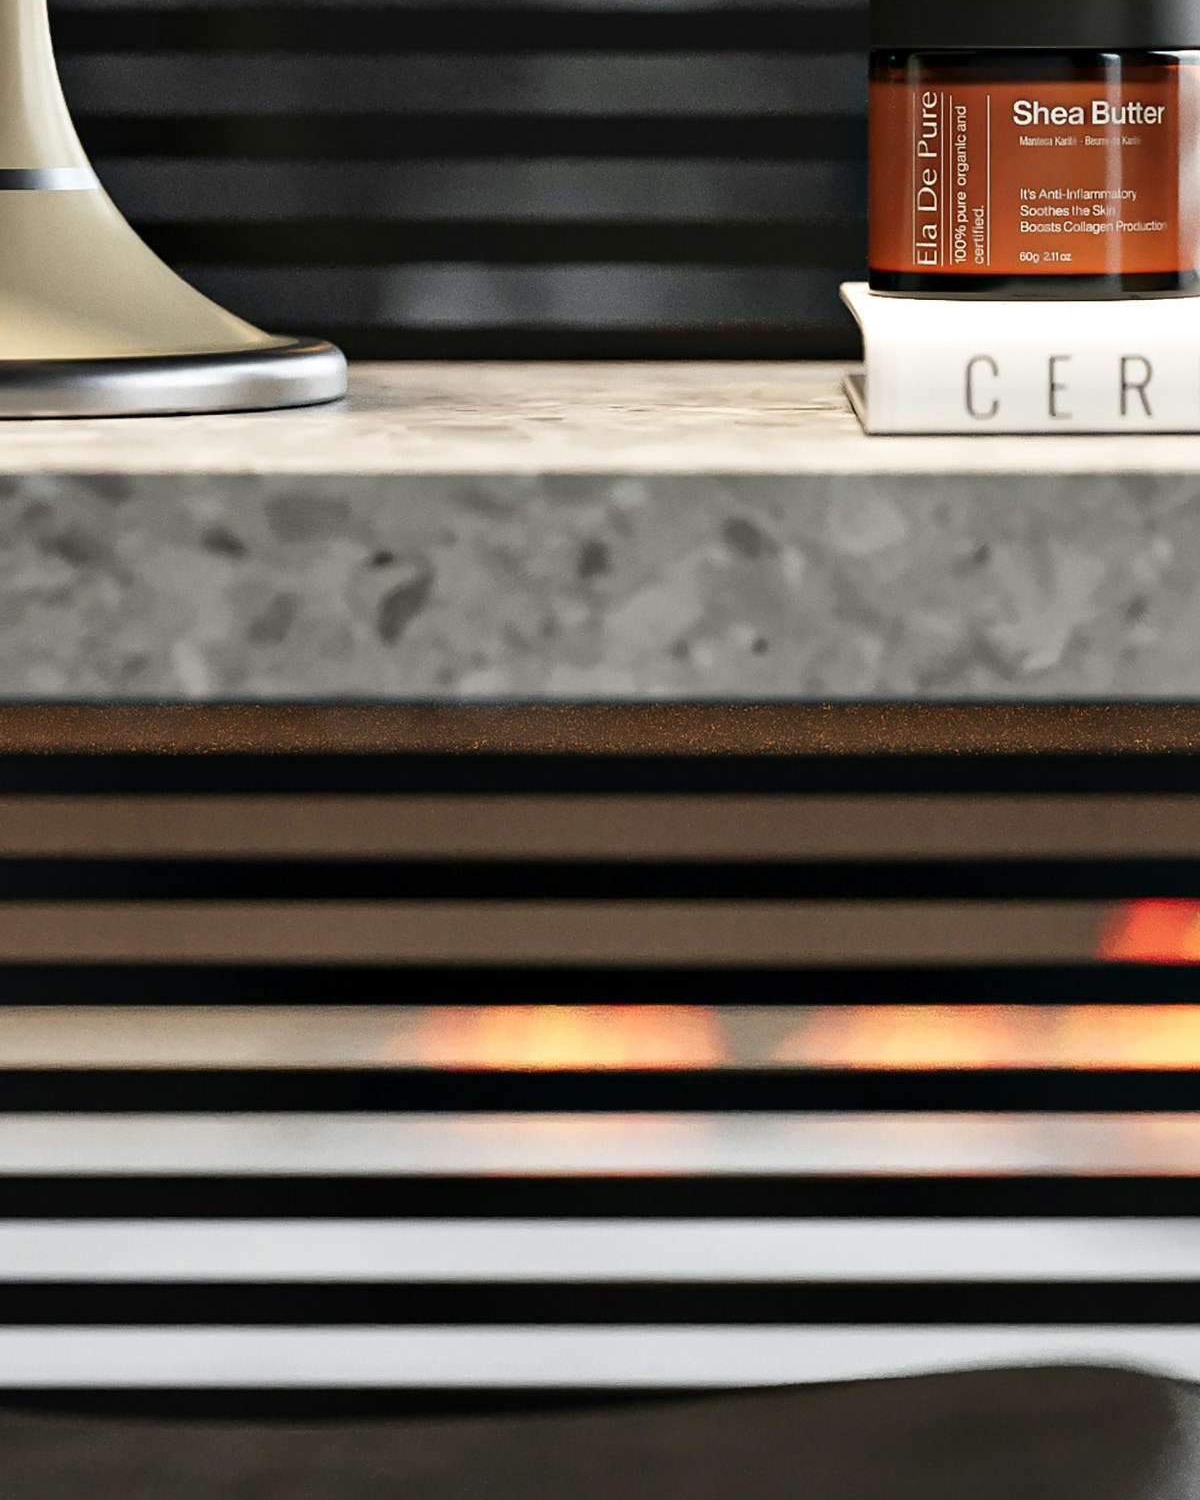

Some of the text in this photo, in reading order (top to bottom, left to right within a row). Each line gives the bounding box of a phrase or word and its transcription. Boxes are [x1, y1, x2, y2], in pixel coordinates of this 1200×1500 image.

[1013, 99, 1166, 126] Shea Butter
[915, 91, 938, 266] Ela De Pure
[954, 105, 970, 264] 100% pure organic and
[1038, 187, 1137, 202] Anti-Inflammatory
[1020, 204, 1116, 217] Soothes the Skin
[971, 205, 985, 265] certified.
[1020, 219, 1168, 235] Boosts Collagen Production
[1019, 251, 1040, 264] 60g
[1060, 253, 1072, 262] oz
